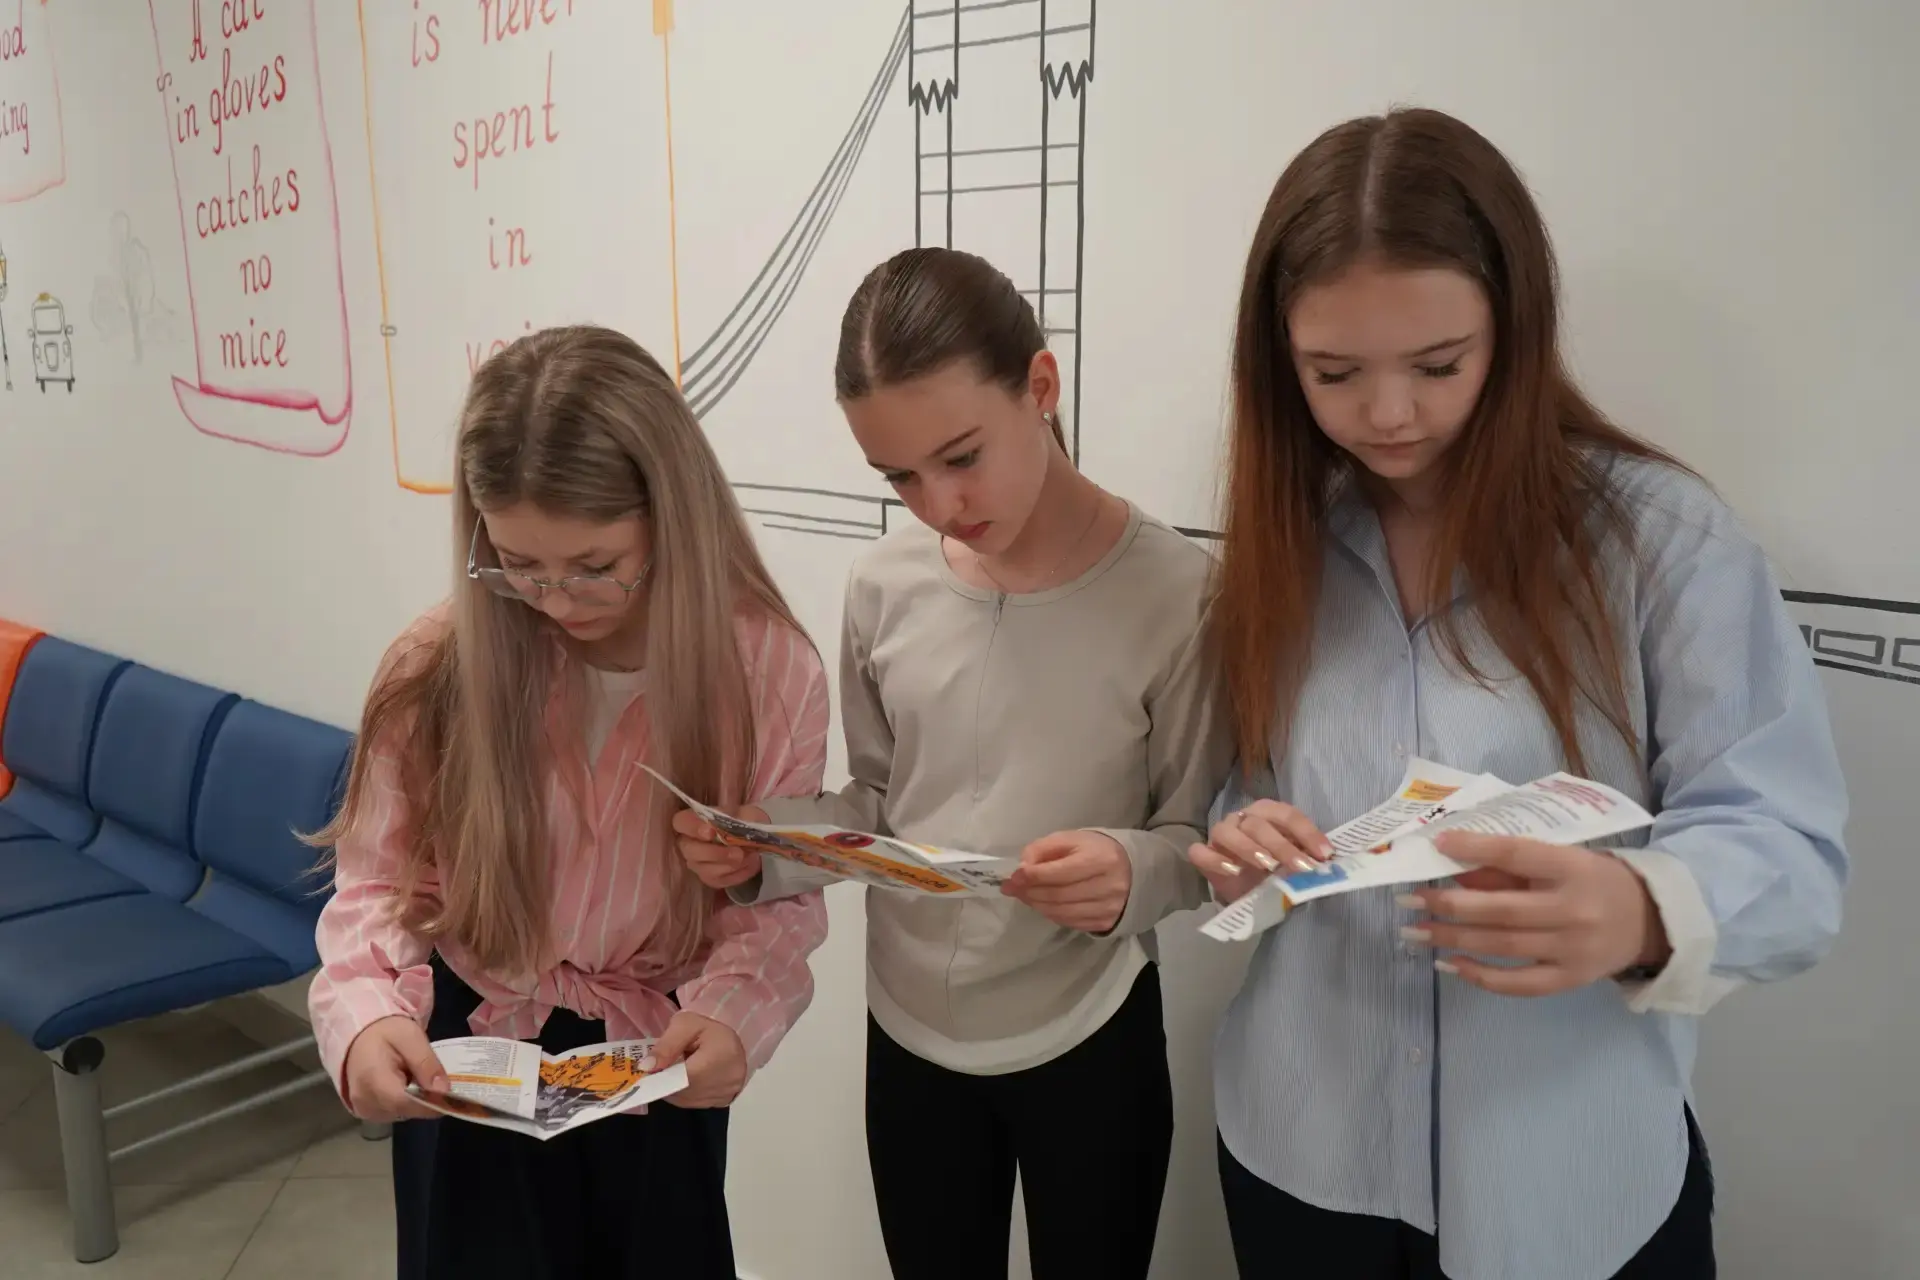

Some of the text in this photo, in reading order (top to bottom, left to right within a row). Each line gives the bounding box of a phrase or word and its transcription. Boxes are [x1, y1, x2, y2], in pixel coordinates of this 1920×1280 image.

[0, 0, 27, 61] od
[221, 0, 264, 39] ca
[412, 0, 440, 68] is
[0, 100, 30, 155] ing
[176, 47, 287, 156] in gloves
[453, 50, 560, 192] spent
[196, 143, 300, 239] catches
[487, 216, 532, 271] in
[239, 254, 272, 295] no
[219, 317, 289, 369] mice
